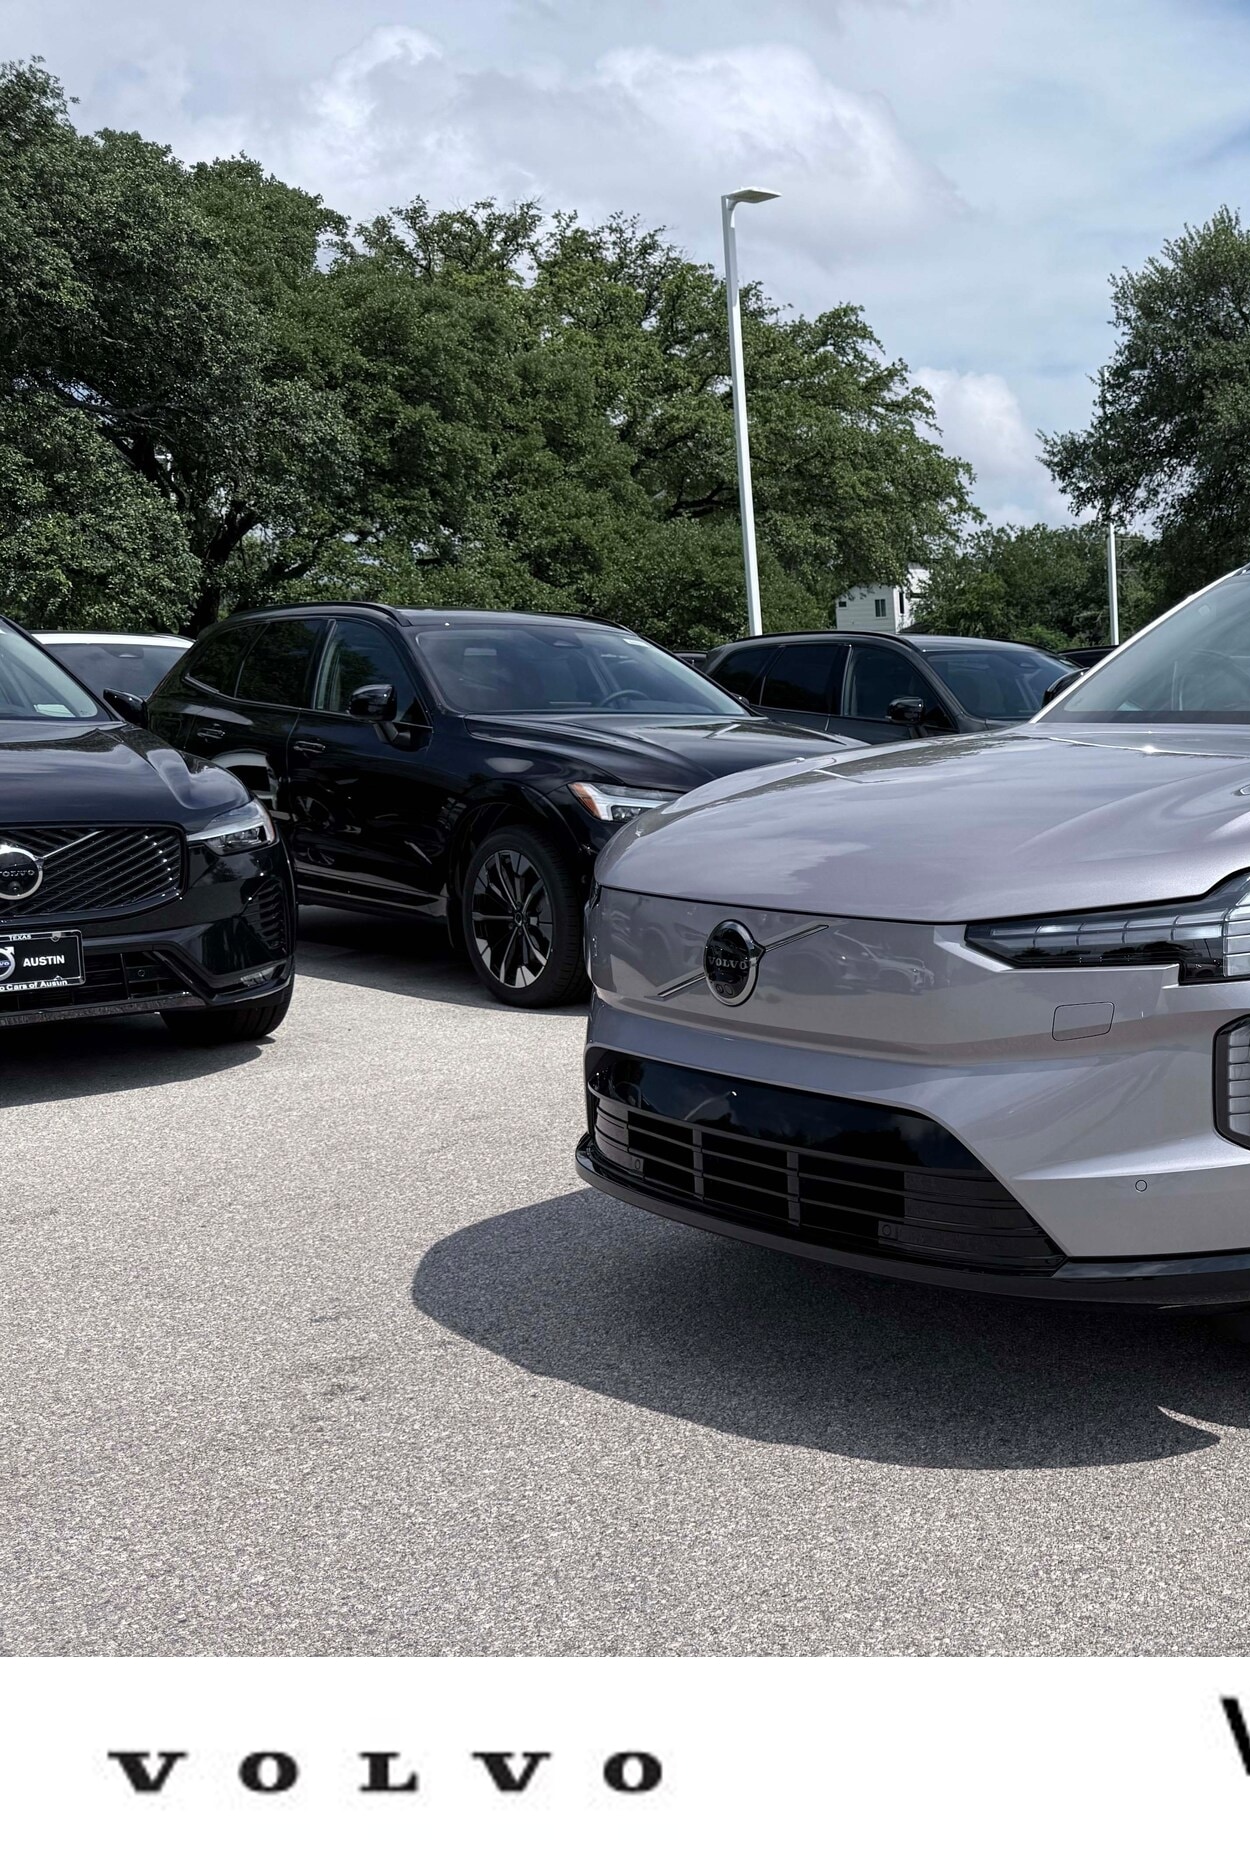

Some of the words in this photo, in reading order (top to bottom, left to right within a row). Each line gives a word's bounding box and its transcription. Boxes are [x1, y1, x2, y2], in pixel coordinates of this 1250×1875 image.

[9, 933, 32, 942] TEXAS
[22, 954, 65, 968] AUSTIN
[707, 955, 749, 971] VOLVO
[6, 983, 28, 992] Cars
[29, 981, 38, 989] of
